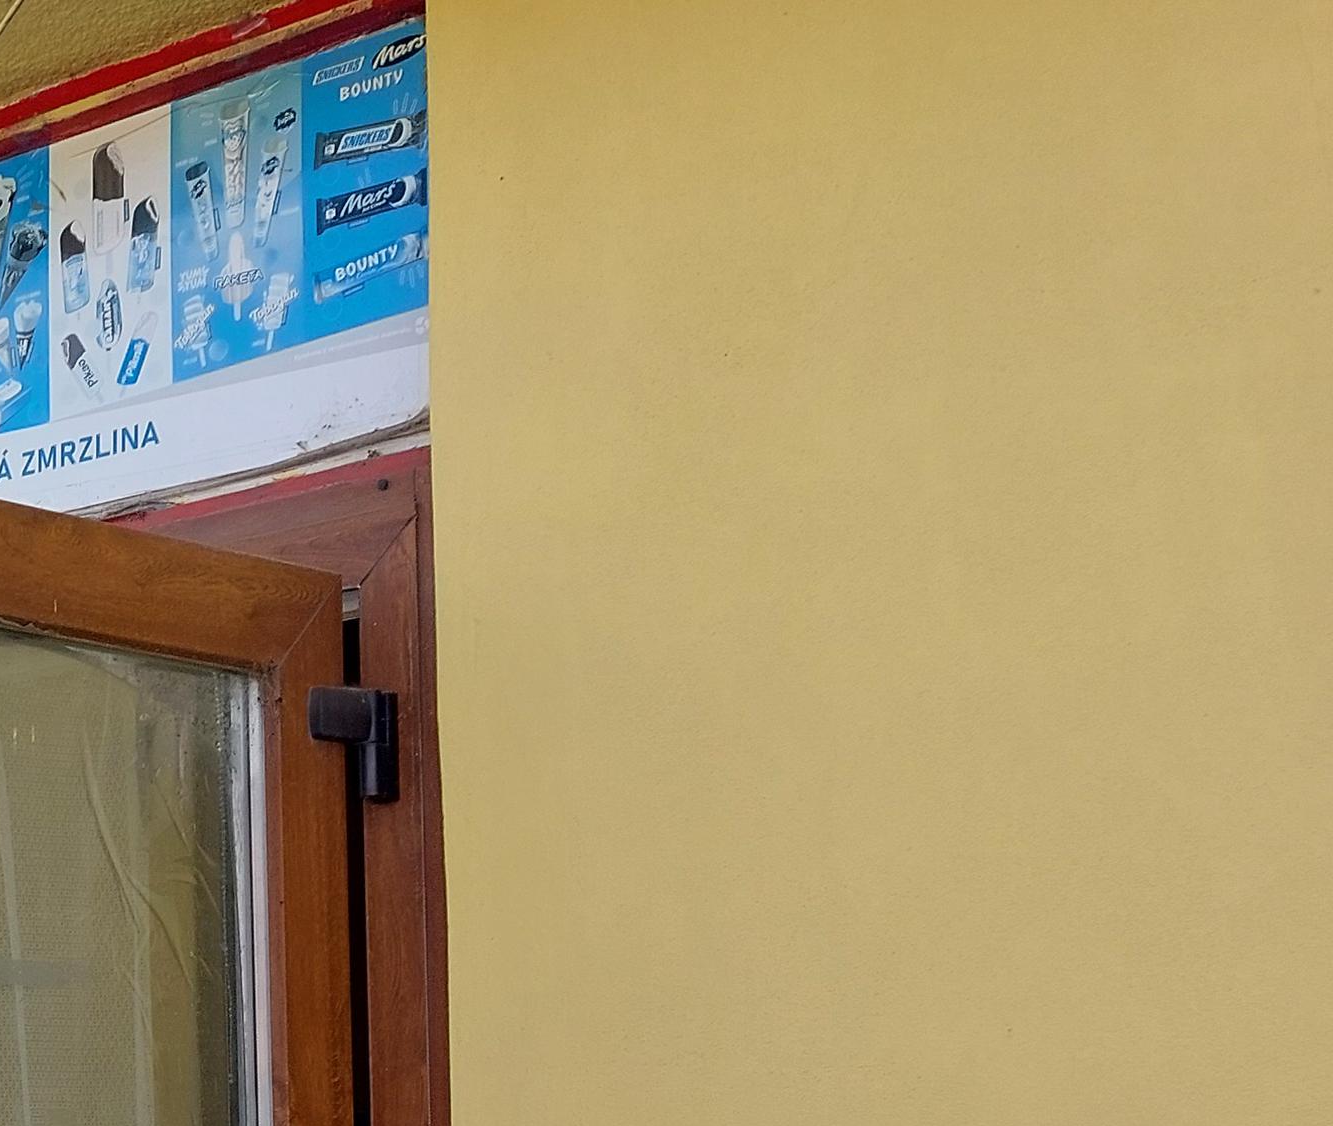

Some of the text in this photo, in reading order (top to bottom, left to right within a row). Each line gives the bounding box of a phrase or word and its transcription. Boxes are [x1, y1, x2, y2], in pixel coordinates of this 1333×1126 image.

[373, 34, 426, 69] Mars
[316, 57, 362, 83] SNICKERS
[340, 68, 404, 101] BOUNTY
[341, 127, 392, 150] SNICKERS
[340, 180, 396, 217] Mars
[213, 268, 263, 291] RAKETA
[335, 244, 398, 282] BOUNTY
[249, 287, 300, 322] Tobogan
[174, 303, 215, 349] Tobogan
[78, 357, 99, 388] Pikao
[21, 420, 160, 478] ZMRZLINA
